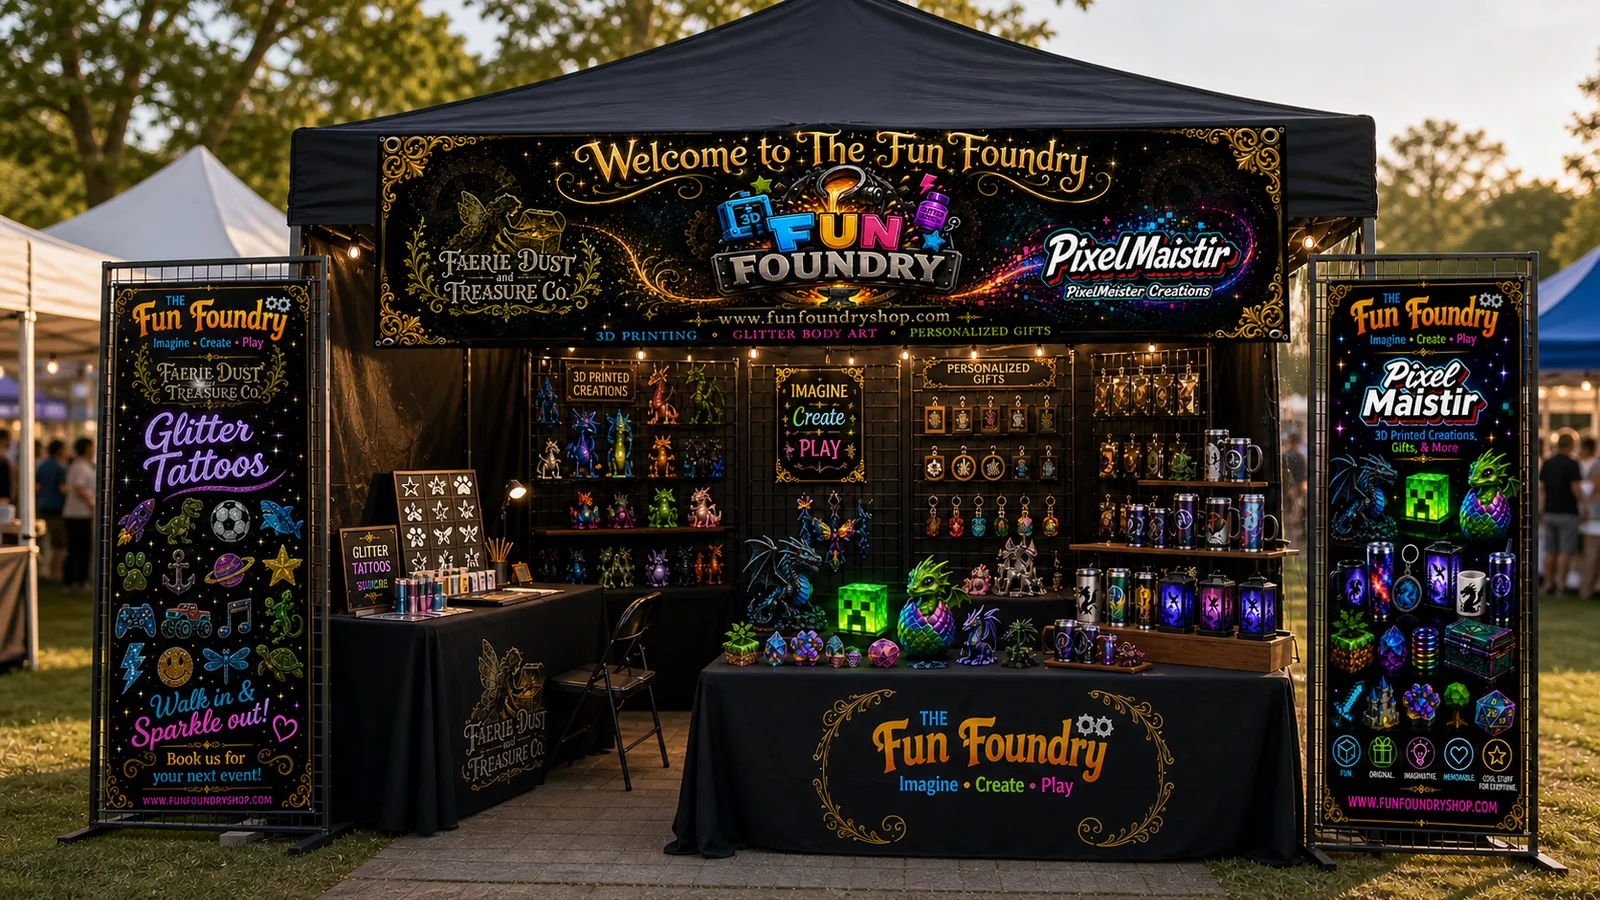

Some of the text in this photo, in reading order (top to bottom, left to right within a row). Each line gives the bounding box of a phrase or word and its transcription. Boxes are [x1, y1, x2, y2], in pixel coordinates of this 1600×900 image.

[574, 129, 1089, 193] Welcome to The Fun Foundry
[741, 210, 760, 225] 3D
[766, 211, 903, 252] FUN
[438, 247, 577, 279] FAERIE DUST
[1045, 233, 1231, 277] PixelMaistir
[496, 271, 514, 282] and
[729, 250, 945, 286] FOUNDRY
[165, 295, 185, 306] THE
[443, 279, 570, 304] TREASURE Co.
[1066, 283, 1212, 299] PixelMeister Creations
[1382, 292, 1400, 304] THE
[132, 298, 288, 342] Fun Foundry
[718, 309, 950, 326] www.funfoundryshop.com
[1350, 295, 1500, 338] Fun Foundry
[153, 336, 265, 350] Imagine Create Play
[596, 325, 1052, 342] 3D PRINTING GLITTER BODY ART PERSONALIZED GIFTS
[1369, 333, 1478, 347] Imagine Create Play
[156, 362, 215, 387] FAERIE
[573, 370, 630, 384] 3D PRINTED
[947, 362, 1030, 374] PERSONALIZED
[1382, 361, 1462, 389] Pixel
[973, 374, 1005, 385] GIFTS
[164, 383, 239, 402] TREASURE
[573, 384, 629, 397] CREATIONS
[791, 383, 849, 398] IMAGINE
[1362, 387, 1479, 417] Maistir
[793, 405, 846, 427] Create
[144, 411, 254, 453] Glitter
[1374, 430, 1388, 441] 3D
[1390, 429, 1426, 441] Printed
[798, 438, 842, 460] PLAY
[1391, 441, 1459, 454] Gifts, & More
[142, 448, 270, 493] Tattoos
[352, 544, 389, 559] GLITTER
[351, 560, 392, 575] TATTOOS
[150, 679, 255, 719] Walk in &
[131, 697, 270, 751] Sparkle out!
[919, 710, 948, 727] THE
[463, 707, 548, 756] FAERIE DUST
[503, 736, 516, 750] and
[872, 715, 1108, 783] Fun Foundry
[166, 750, 246, 767] Book us for
[467, 737, 545, 782] TREASURE Co.
[152, 767, 262, 786] your next event!
[899, 775, 1074, 798] Imagine Create Play
[142, 795, 273, 806] WWW.FUNFOUNDRYSHOP.COM
[1347, 795, 1498, 814] WWW.FUNFOUNDRYSHOP.COM
